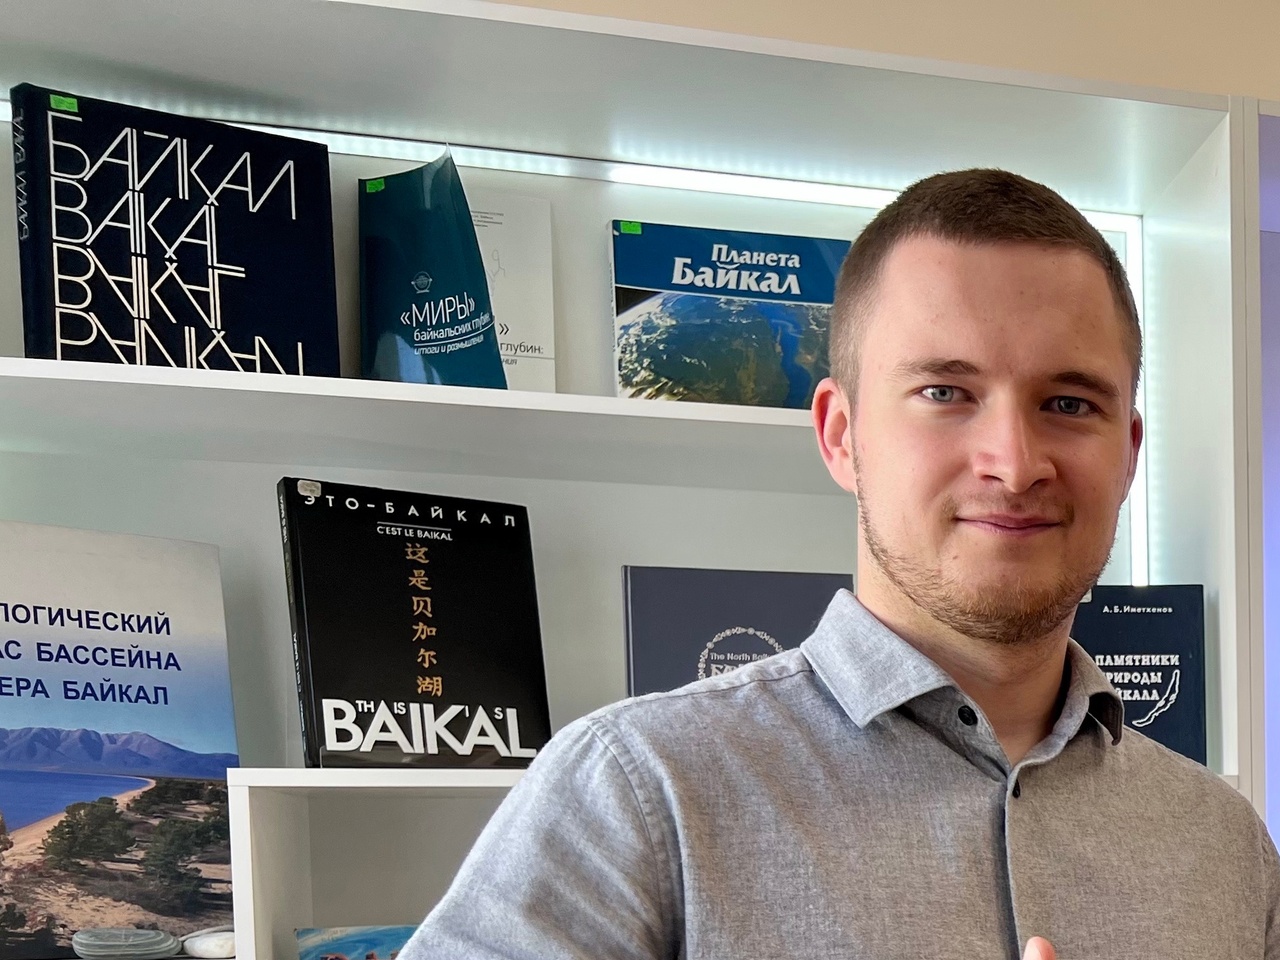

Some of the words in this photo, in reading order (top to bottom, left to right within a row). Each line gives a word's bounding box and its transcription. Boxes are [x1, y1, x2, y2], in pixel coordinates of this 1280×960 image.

[711, 243, 801, 268] Планета
[671, 256, 802, 295] Байкал
[400, 291, 476, 328] «МИРЫ»
[500, 342, 544, 355] глубин:
[404, 528, 415, 538] LE
[417, 530, 453, 541] BAIKAL
[404, 542, 444, 697] 这是贝加尔湖
[36, 642, 182, 672] БАССЕЙНА
[710, 652, 726, 660] The
[1095, 654, 1180, 666] ПАМЯТНИКИ
[63, 678, 169, 706] БАЙКАЛ
[1104, 672, 1163, 686] РИРОДЫ
[322, 698, 537, 758] BAIKAL
